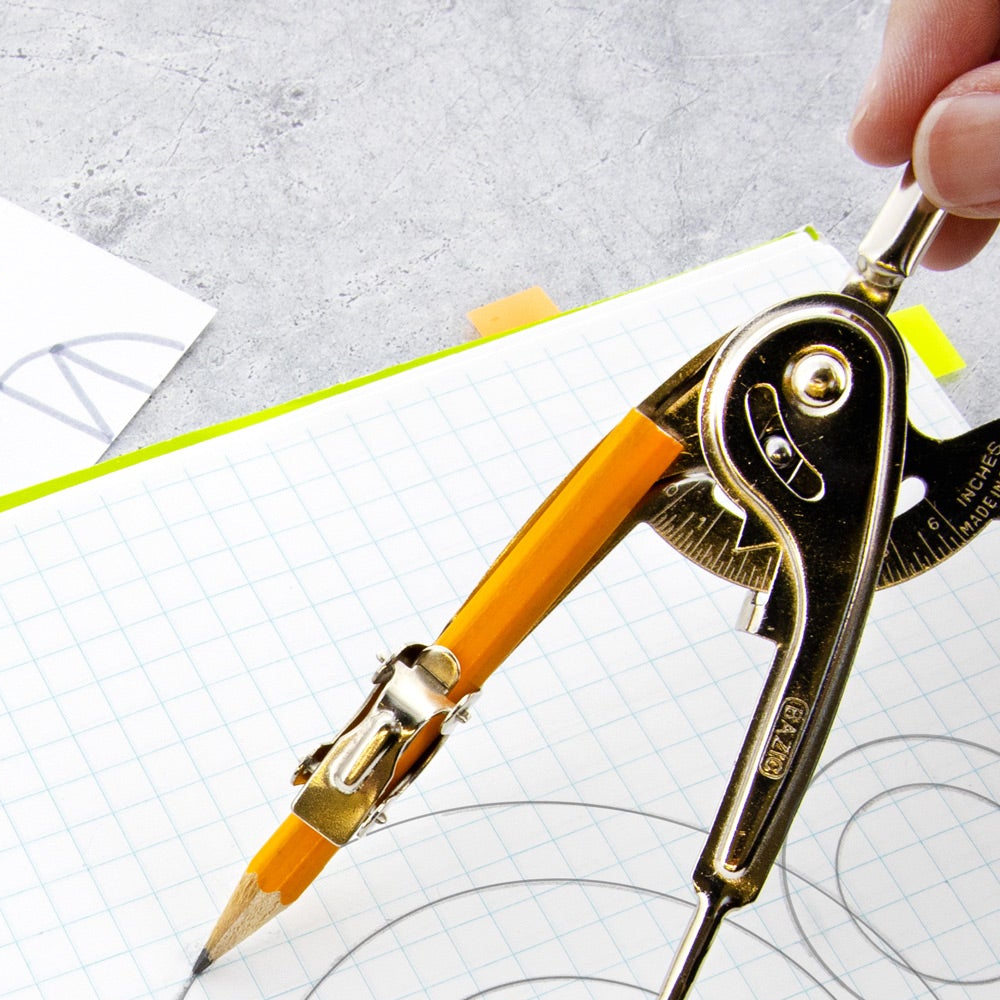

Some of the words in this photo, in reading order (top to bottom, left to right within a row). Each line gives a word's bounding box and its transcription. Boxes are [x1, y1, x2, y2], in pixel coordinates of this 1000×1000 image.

[957, 441, 1000, 507] INCHES
[927, 516, 939, 530] 6
[959, 495, 998, 537] MADE
